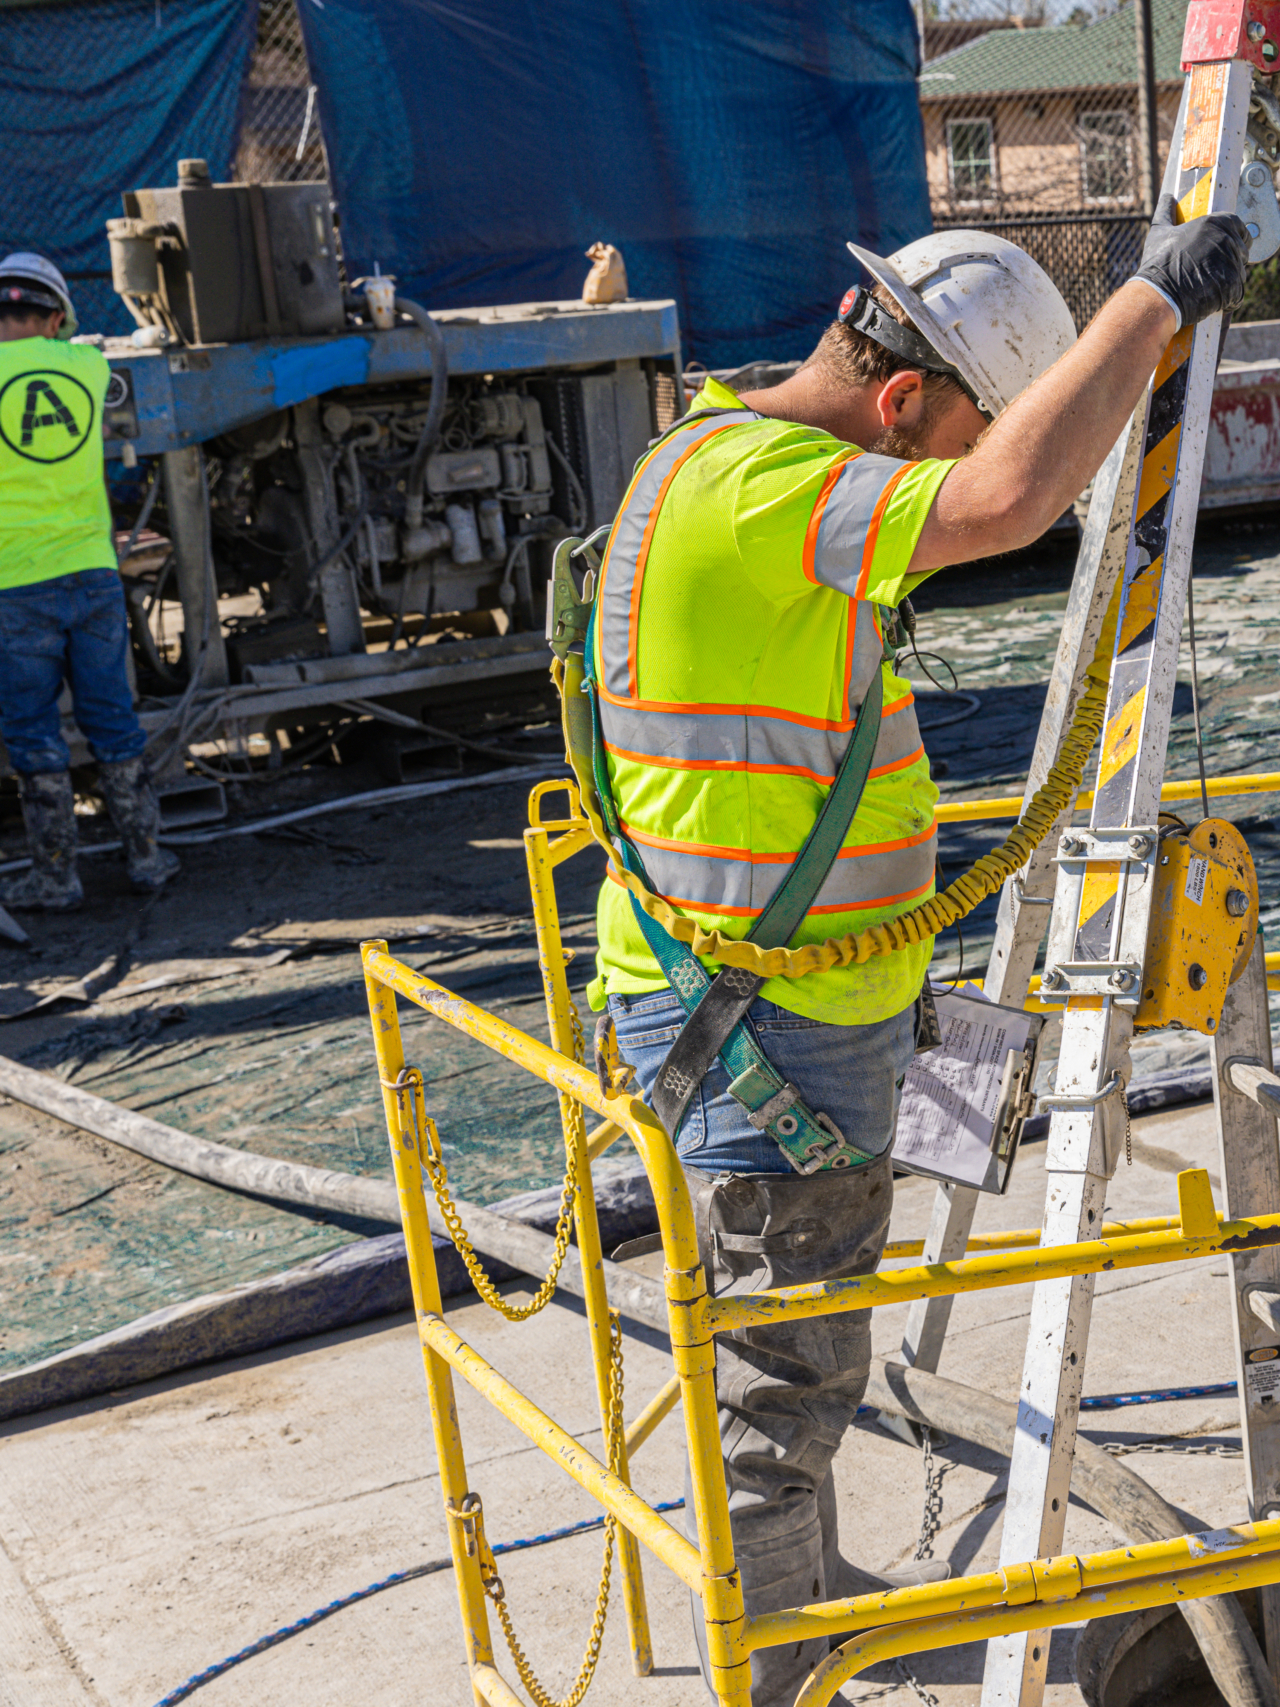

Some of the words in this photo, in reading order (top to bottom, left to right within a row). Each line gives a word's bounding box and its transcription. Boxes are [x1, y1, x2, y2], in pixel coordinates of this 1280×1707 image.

[1216, 64, 1224, 89] EVOR
[1196, 878, 1204, 901] WINCH
[986, 1063, 996, 1090] AUTHORIZED
[980, 1089, 989, 1112] ENTRANTS
